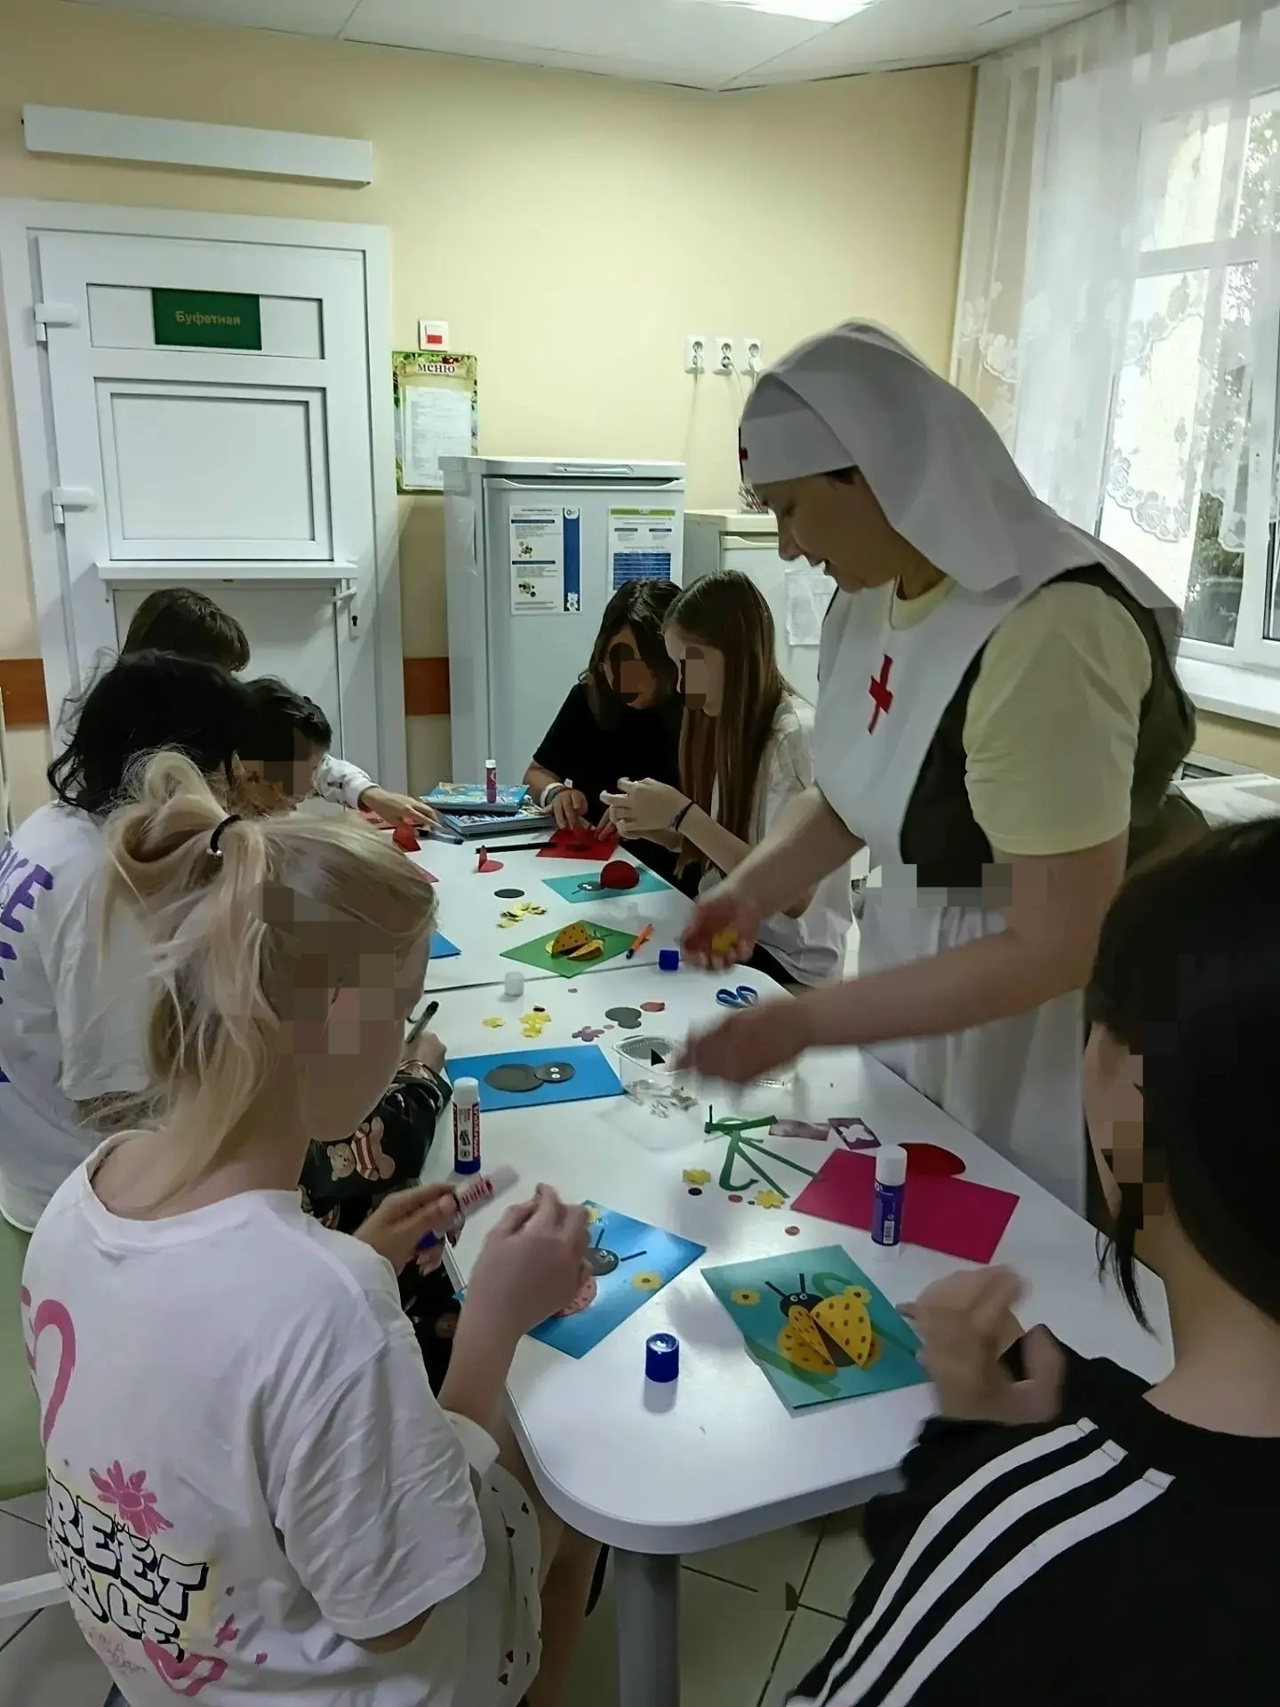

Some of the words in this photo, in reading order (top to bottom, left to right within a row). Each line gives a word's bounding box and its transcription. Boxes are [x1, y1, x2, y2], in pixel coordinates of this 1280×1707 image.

[175, 310, 241, 326] Буфетная
[417, 363, 456, 375] меню
[46, 1467, 210, 1621] REET
